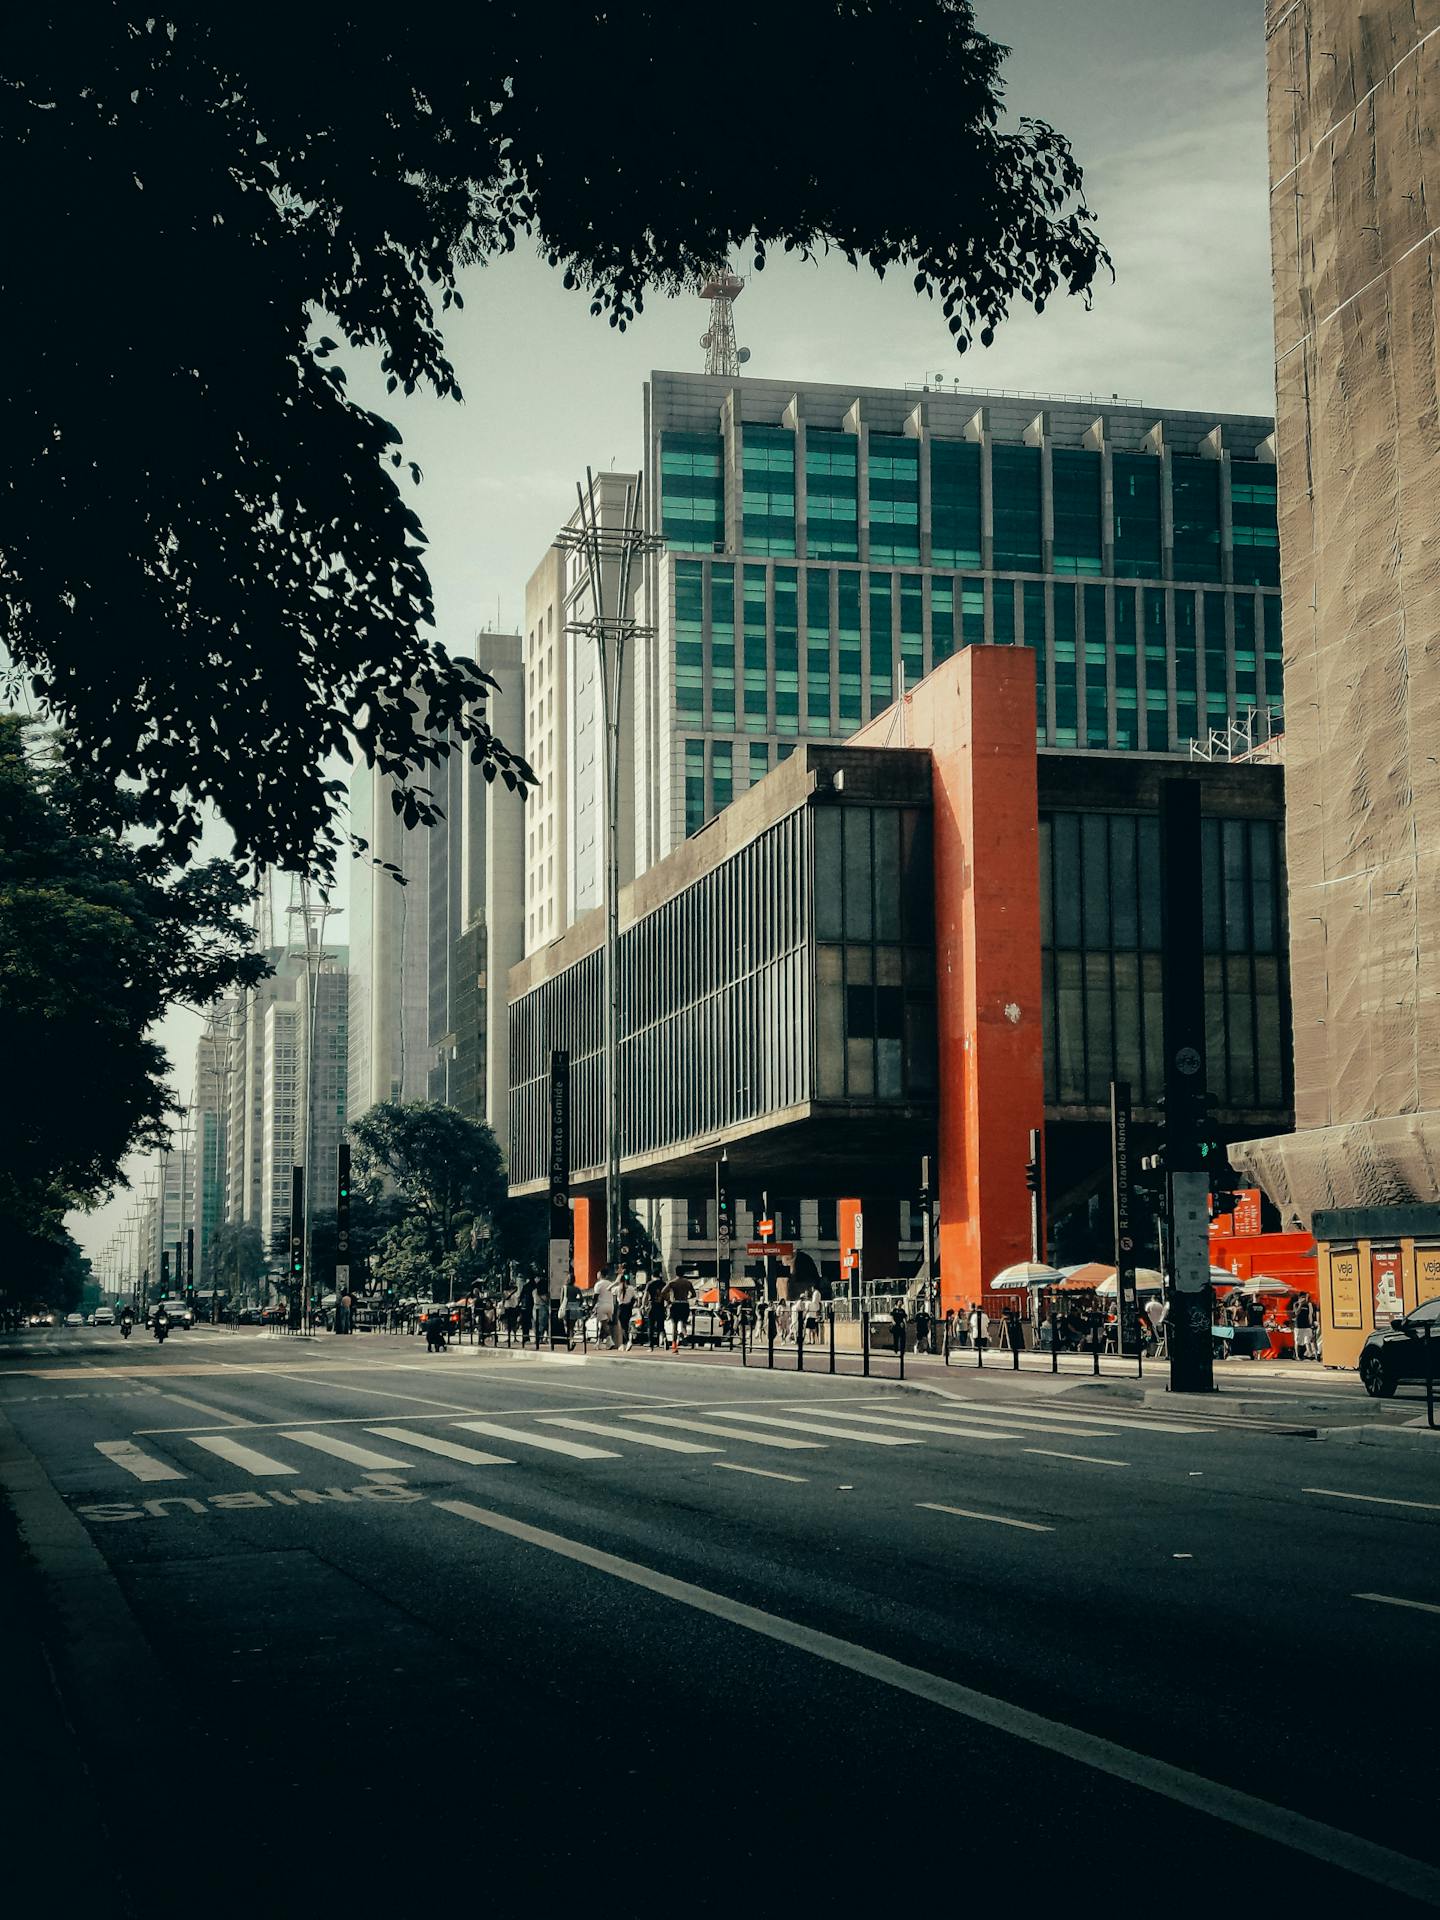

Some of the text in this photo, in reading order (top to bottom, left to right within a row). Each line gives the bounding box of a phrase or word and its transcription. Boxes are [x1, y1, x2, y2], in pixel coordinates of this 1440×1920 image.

[553, 1081, 563, 1125] Gomide
[553, 1127, 563, 1171] Peixoto
[1117, 1111, 1126, 1152] Mendes
